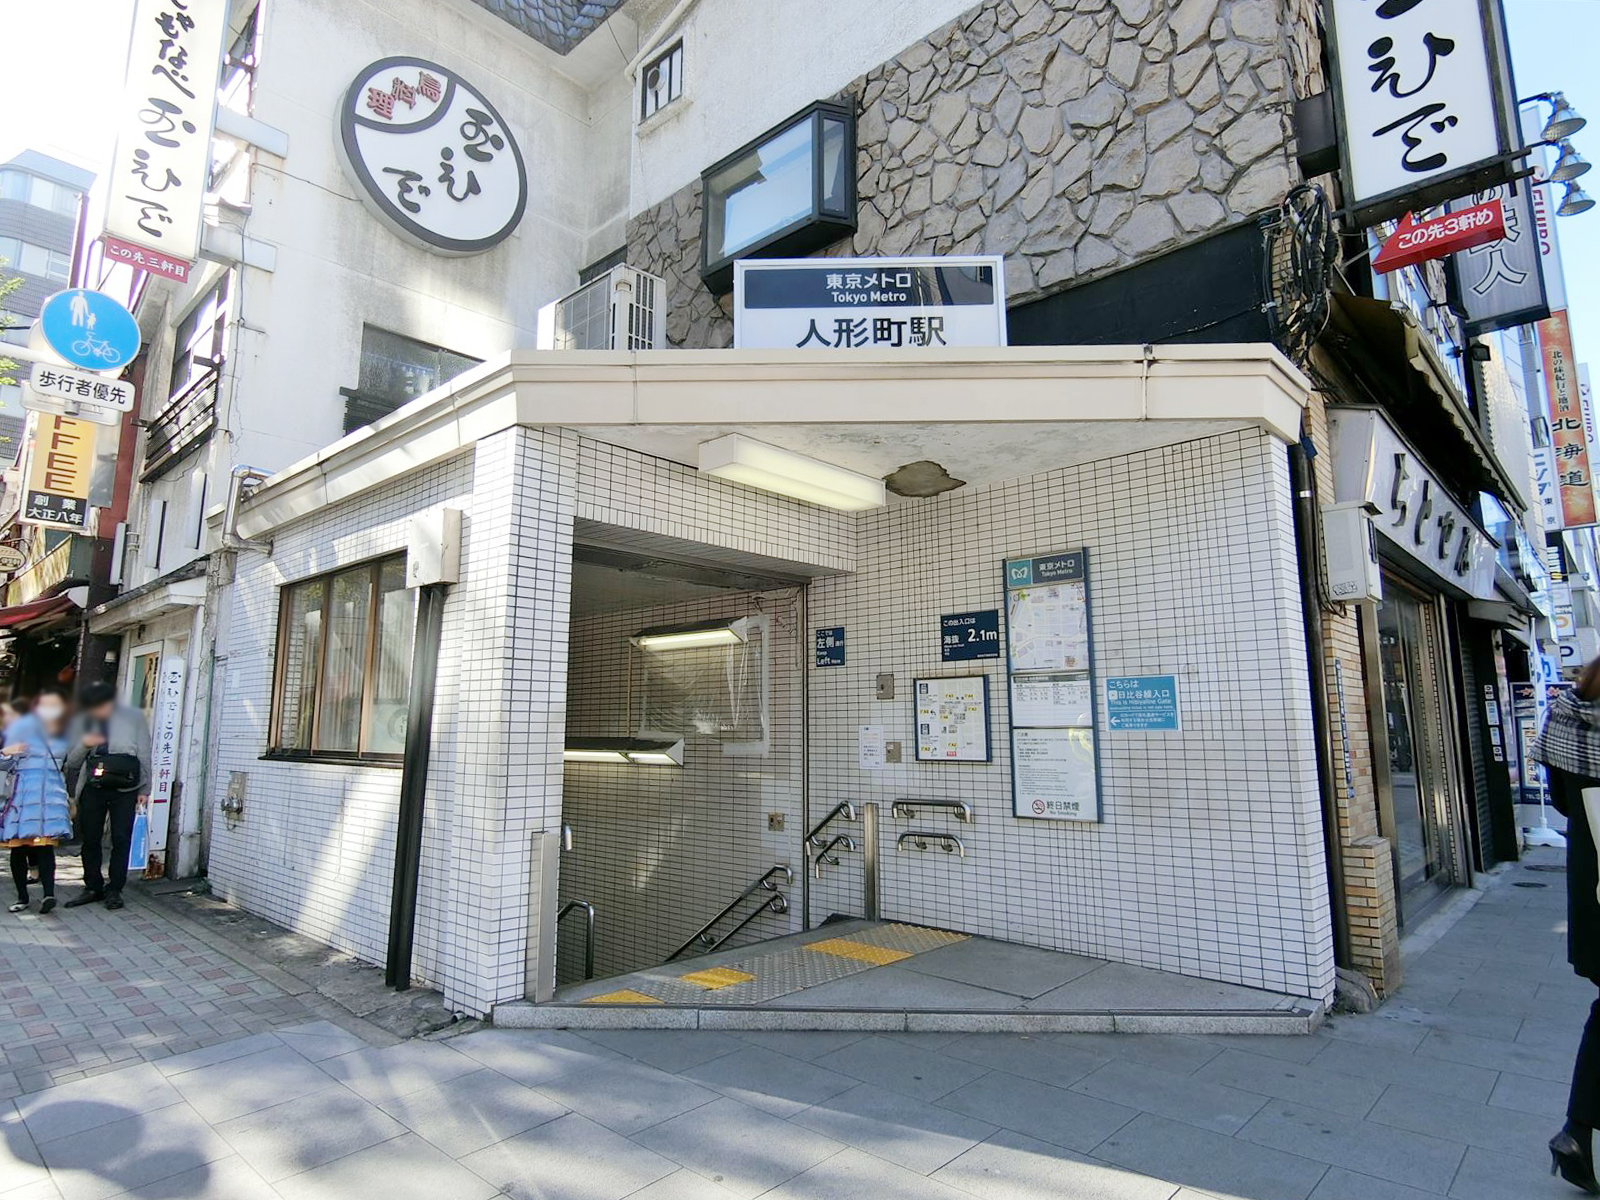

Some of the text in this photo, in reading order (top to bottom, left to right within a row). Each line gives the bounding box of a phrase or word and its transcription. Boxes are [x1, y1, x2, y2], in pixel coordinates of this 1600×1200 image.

[1398, 207, 1494, 249] この先3軒め
[109, 244, 186, 277] この先三軒目
[825, 272, 912, 290] 東京メトロ
[831, 290, 907, 304] Tokyo Metro
[795, 316, 948, 349] 人形町駅
[39, 371, 126, 405] 歩行者優先
[1551, 417, 1589, 488] 北海道
[33, 494, 77, 511] 創業
[28, 507, 83, 524] 大正八年
[1039, 559, 1075, 572] 東京メトロ
[967, 628, 997, 642] 2.1m
[1109, 680, 1139, 689] こちらは
[1118, 689, 1170, 699] 日比谷線入口
[1046, 801, 1080, 811] 終日禁煙
